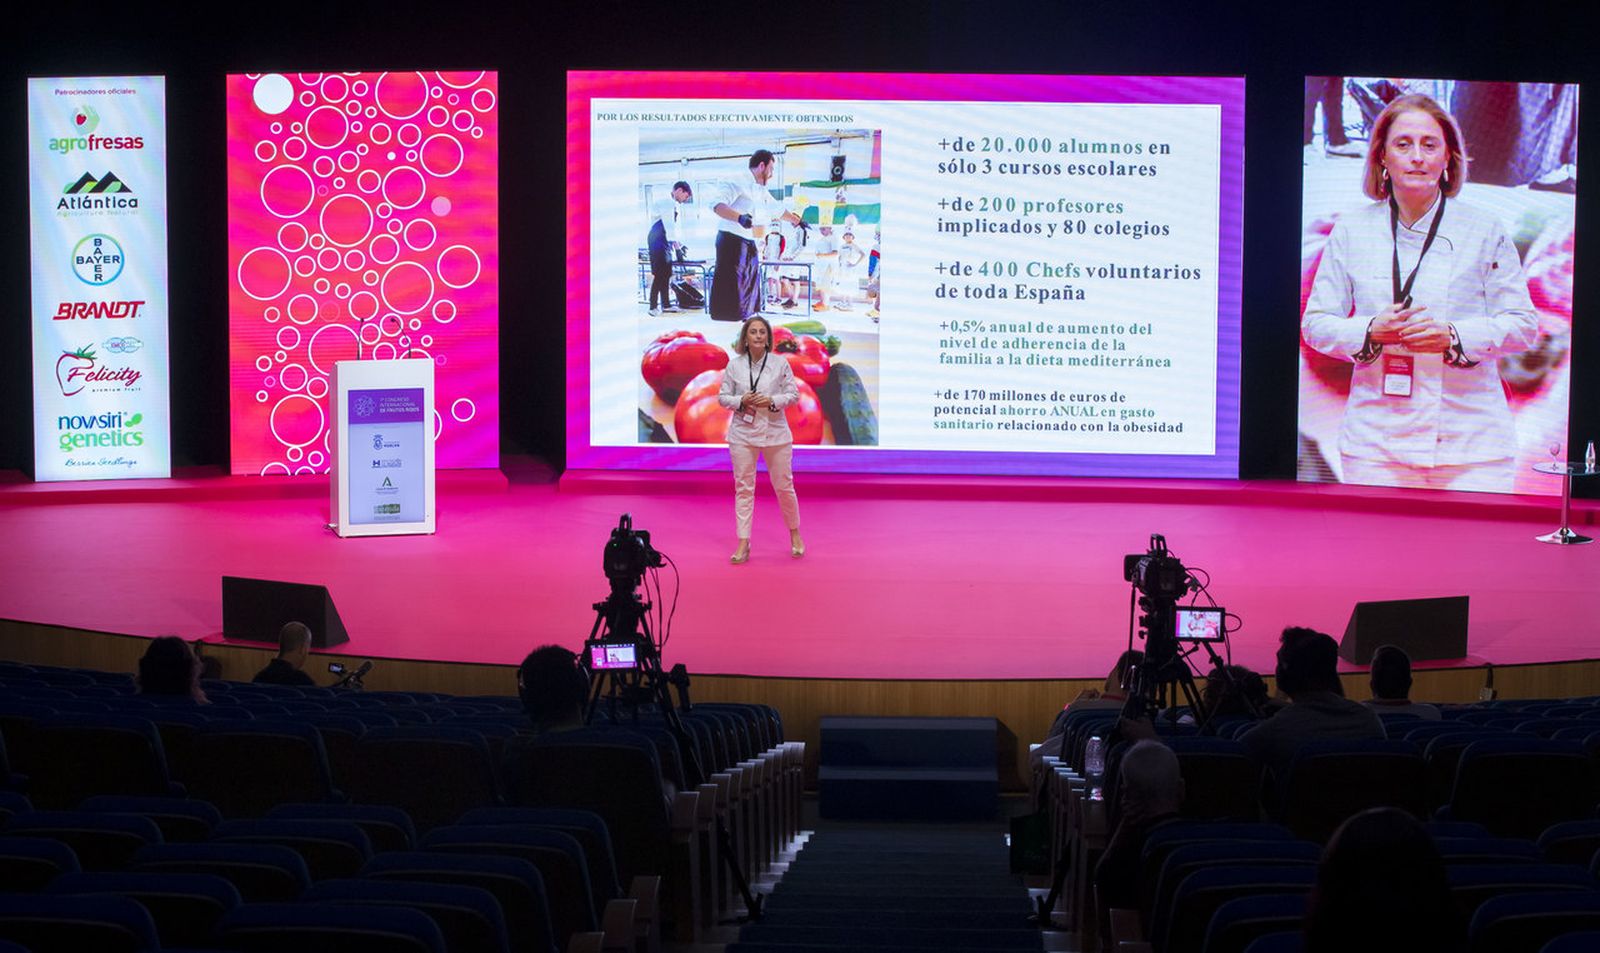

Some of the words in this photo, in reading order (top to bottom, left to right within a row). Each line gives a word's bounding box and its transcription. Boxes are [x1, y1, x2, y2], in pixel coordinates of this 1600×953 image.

[596, 112, 617, 122] POR
[620, 113, 639, 122] LOS
[641, 114, 706, 122] RESULTADOS
[709, 114, 794, 122] EFECTIVAMENTE
[796, 114, 854, 123] OBTENIDOS
[50, 134, 144, 154] agrofresas
[938, 136, 975, 153] +de
[981, 137, 1051, 154] 20.000
[1058, 138, 1142, 154] alumnos
[1149, 143, 1170, 155] en
[938, 158, 976, 175] sólo
[982, 159, 992, 174] 3
[999, 162, 1062, 176] cursos
[1067, 160, 1157, 177] escolares
[57, 196, 138, 210] Atlántica
[938, 197, 974, 212] +de
[979, 197, 1016, 212] 200
[1023, 198, 1124, 216] profesores
[938, 218, 1042, 237] implicados
[1047, 222, 1058, 238] y
[1063, 220, 1086, 235] 80
[1094, 220, 1170, 239] colegios
[76, 255, 120, 264] BAYER
[935, 261, 972, 277] +de
[978, 262, 1018, 278] 400
[1026, 262, 1080, 278] Chefs
[1086, 264, 1200, 280] voluntarios
[935, 284, 958, 299] de
[964, 284, 1008, 300] toda
[1014, 284, 1086, 304] España
[53, 301, 145, 320] BRANDT
[939, 320, 986, 334] +0,5%
[990, 321, 1032, 334] anual
[1036, 321, 1054, 334] de
[1058, 322, 1124, 335] aumento
[1129, 322, 1152, 335] del
[939, 336, 976, 349] nivel
[980, 336, 998, 349] de
[1002, 338, 1086, 350] adherencia
[1092, 338, 1108, 351] de
[1112, 339, 1126, 351] la
[939, 352, 992, 365] familia
[996, 357, 1004, 365] a
[1009, 352, 1022, 366] la
[1026, 353, 1063, 366] dieta
[1068, 354, 1171, 368] mediterránea
[67, 365, 142, 387] Felicity
[934, 389, 960, 400] +de
[964, 390, 986, 400] 170
[990, 390, 1046, 402] millones
[1050, 390, 1066, 402] de
[1070, 393, 1106, 402] euros
[1110, 392, 1126, 402] de
[934, 404, 996, 418] potencial
[1000, 405, 1046, 416] ahorro
[1050, 406, 1098, 417] ANUAL
[1100, 409, 1116, 418] en
[1120, 408, 1155, 420] gasto
[933, 418, 994, 430] sanitario
[998, 420, 1076, 432] relacionado
[1080, 423, 1104, 432] con
[1108, 422, 1120, 432] la
[1124, 422, 1184, 433] obesidad
[60, 430, 144, 452] genetics
